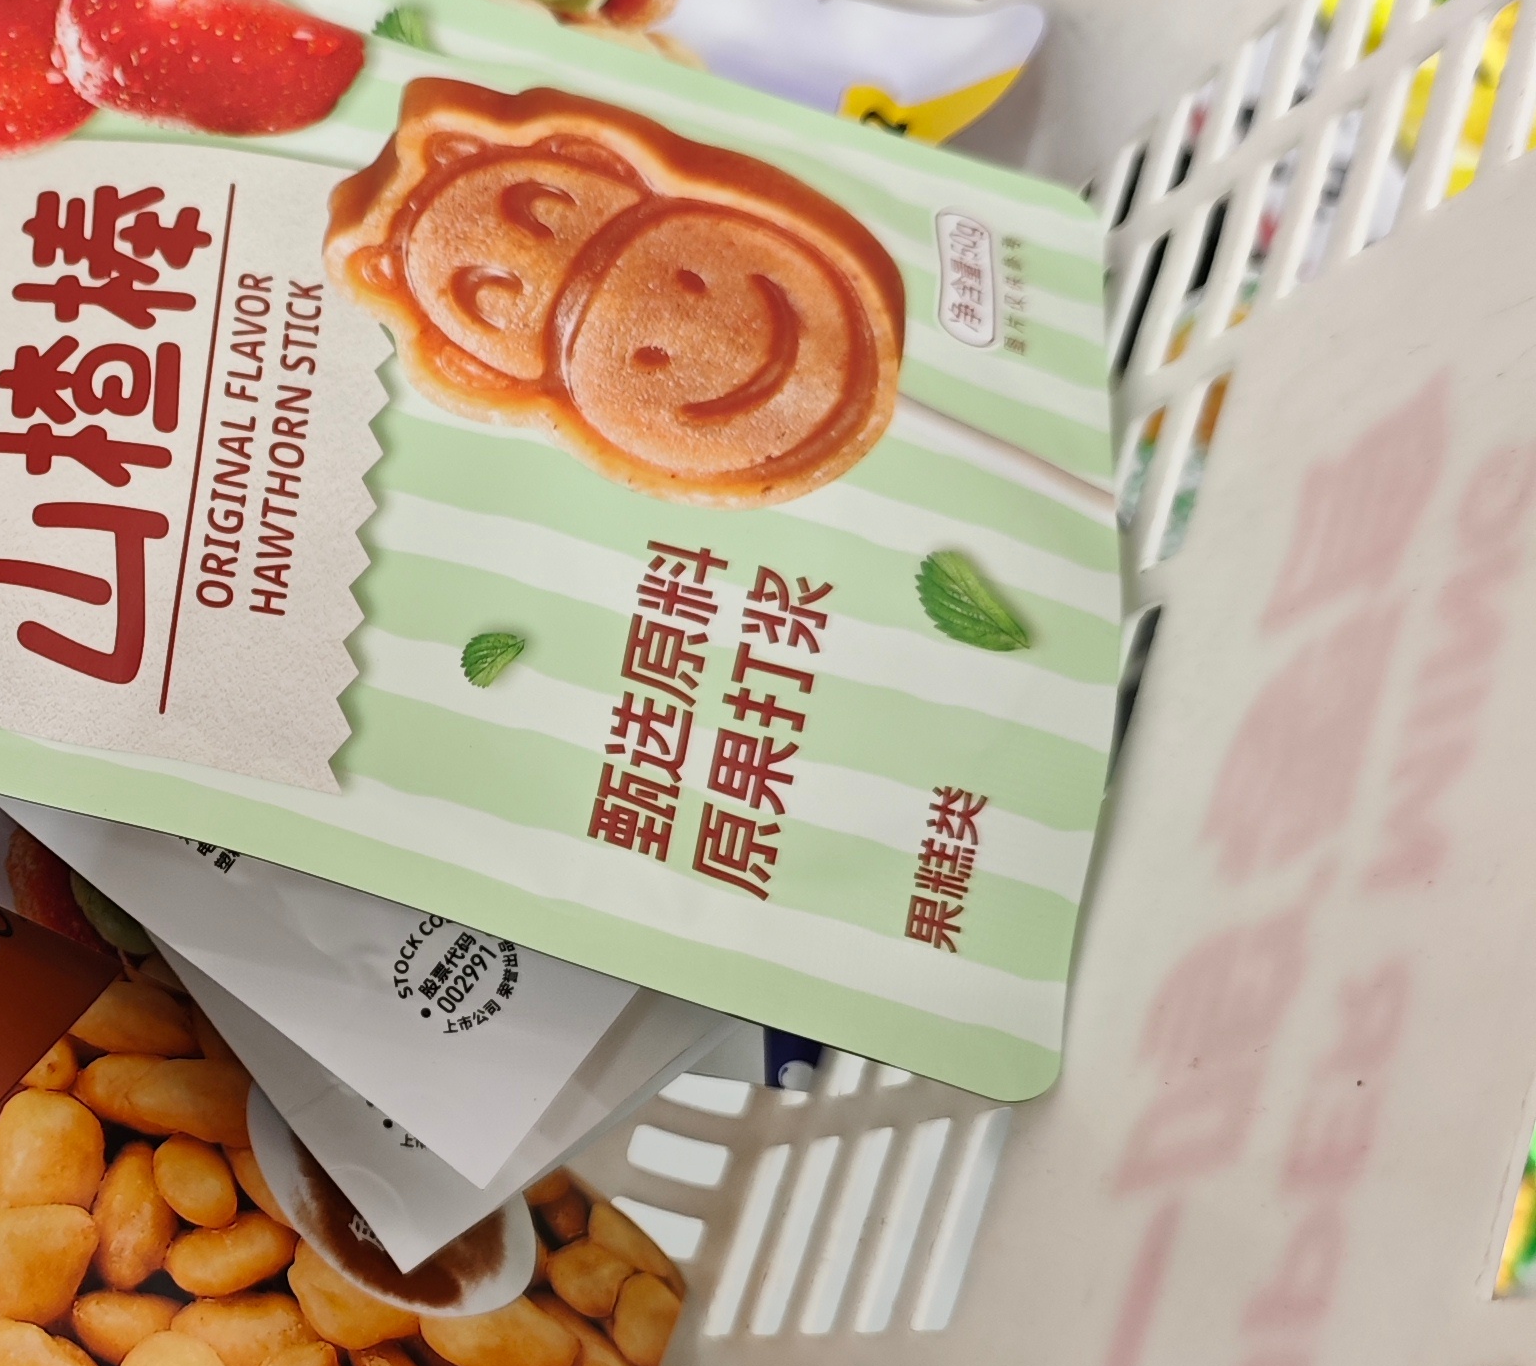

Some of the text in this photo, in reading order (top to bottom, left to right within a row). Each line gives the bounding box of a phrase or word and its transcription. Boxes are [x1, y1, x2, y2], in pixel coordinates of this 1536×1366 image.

[196, 272, 274, 609] ORIGINAL FLAVOR
[250, 281, 325, 617] HAWTHORN STICK
[587, 540, 729, 862] 甄选原料
[692, 565, 833, 901] 原果打浆
[905, 786, 988, 954] 果糕类
[394, 933, 425, 1001] STOCK
[418, 932, 477, 1000] 股票代码
[437, 945, 498, 1015] 002991
[443, 999, 502, 1034] 上市公司
